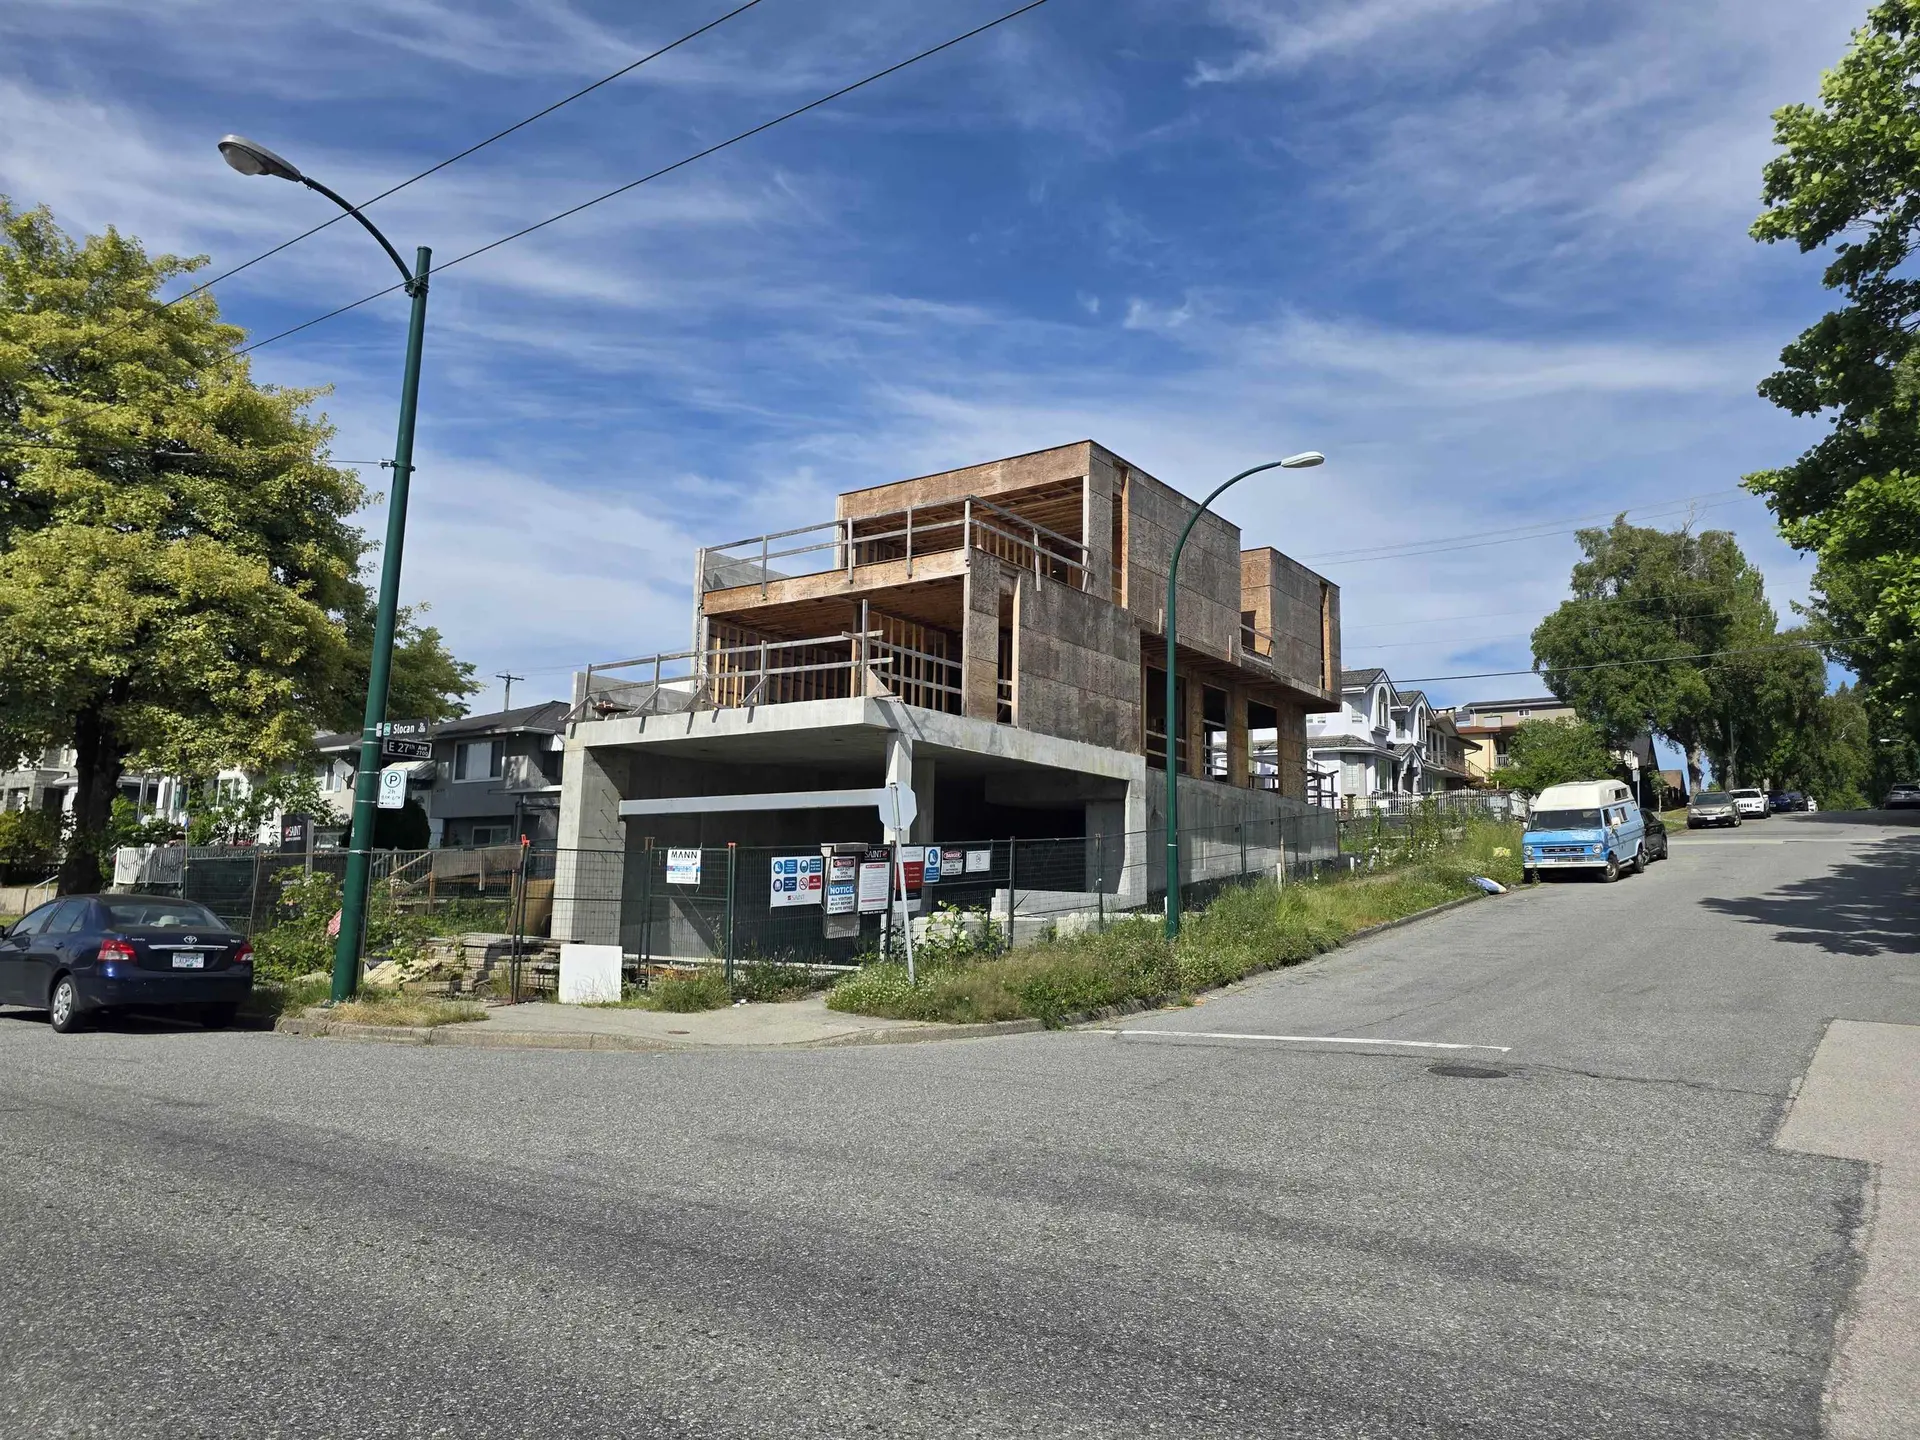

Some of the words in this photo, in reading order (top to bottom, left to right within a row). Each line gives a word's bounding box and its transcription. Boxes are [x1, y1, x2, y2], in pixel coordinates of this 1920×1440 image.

[393, 723, 415, 735] Slocan
[388, 741, 395, 752] E
[390, 775, 398, 784] P
[671, 851, 698, 859] MANN
[864, 850, 882, 858] SAINT
[829, 886, 854, 895] NOTICE
